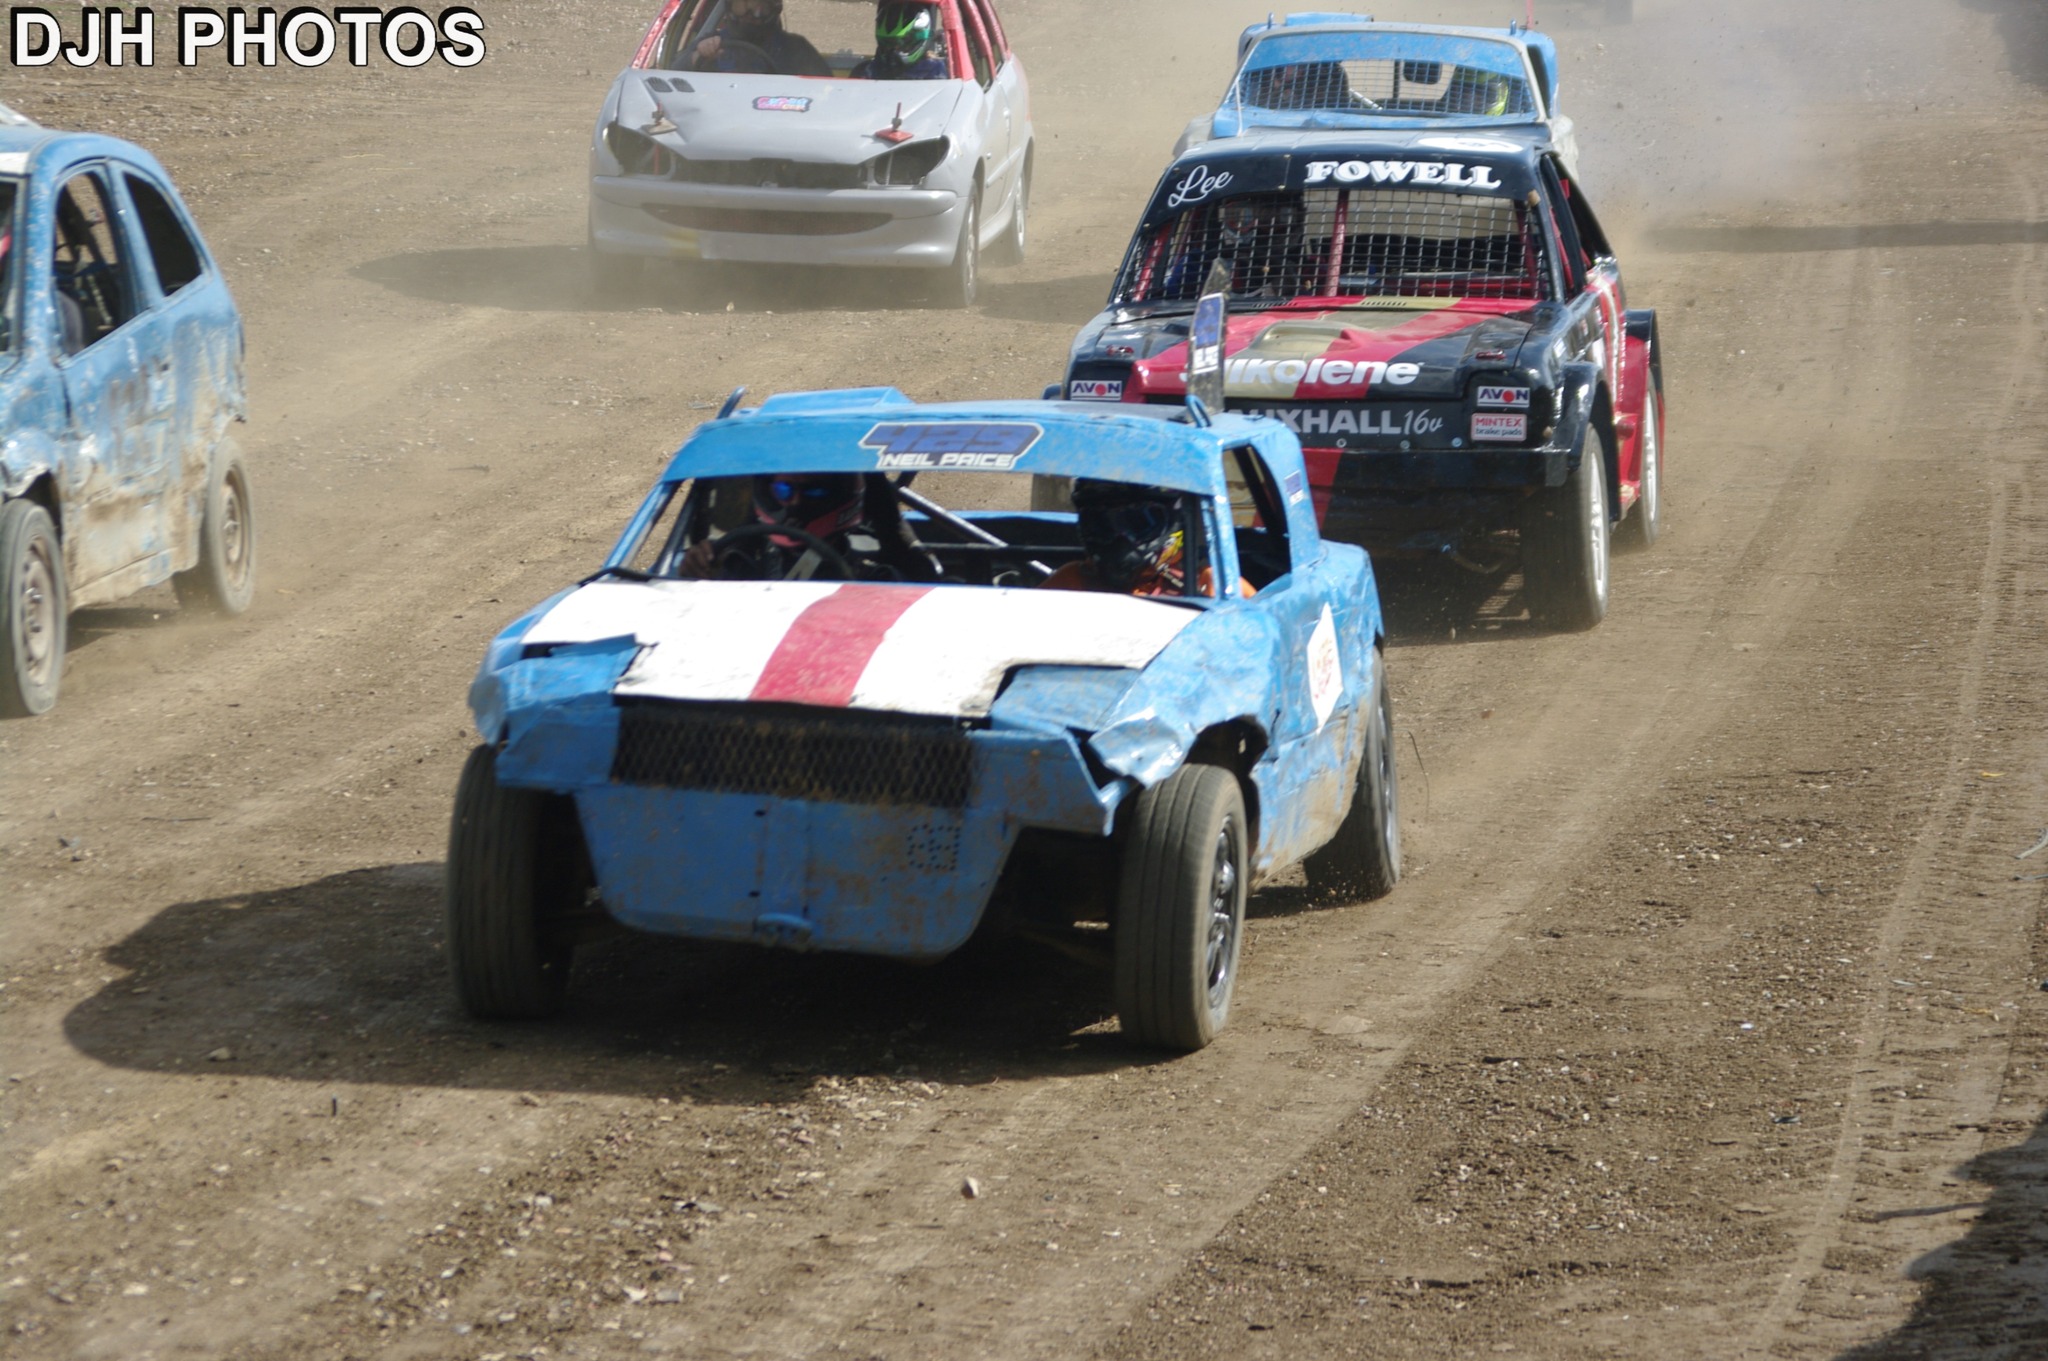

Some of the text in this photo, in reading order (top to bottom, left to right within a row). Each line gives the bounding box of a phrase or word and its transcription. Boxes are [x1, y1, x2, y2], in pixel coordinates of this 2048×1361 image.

[1167, 160, 1502, 207] Lee FOWELL
[1180, 358, 1421, 385] lkolene
[1072, 382, 1120, 397] AVON
[1479, 388, 1529, 403] AVON
[1475, 417, 1522, 427] MINTEX
[882, 453, 1014, 467] NEIL PRICE
